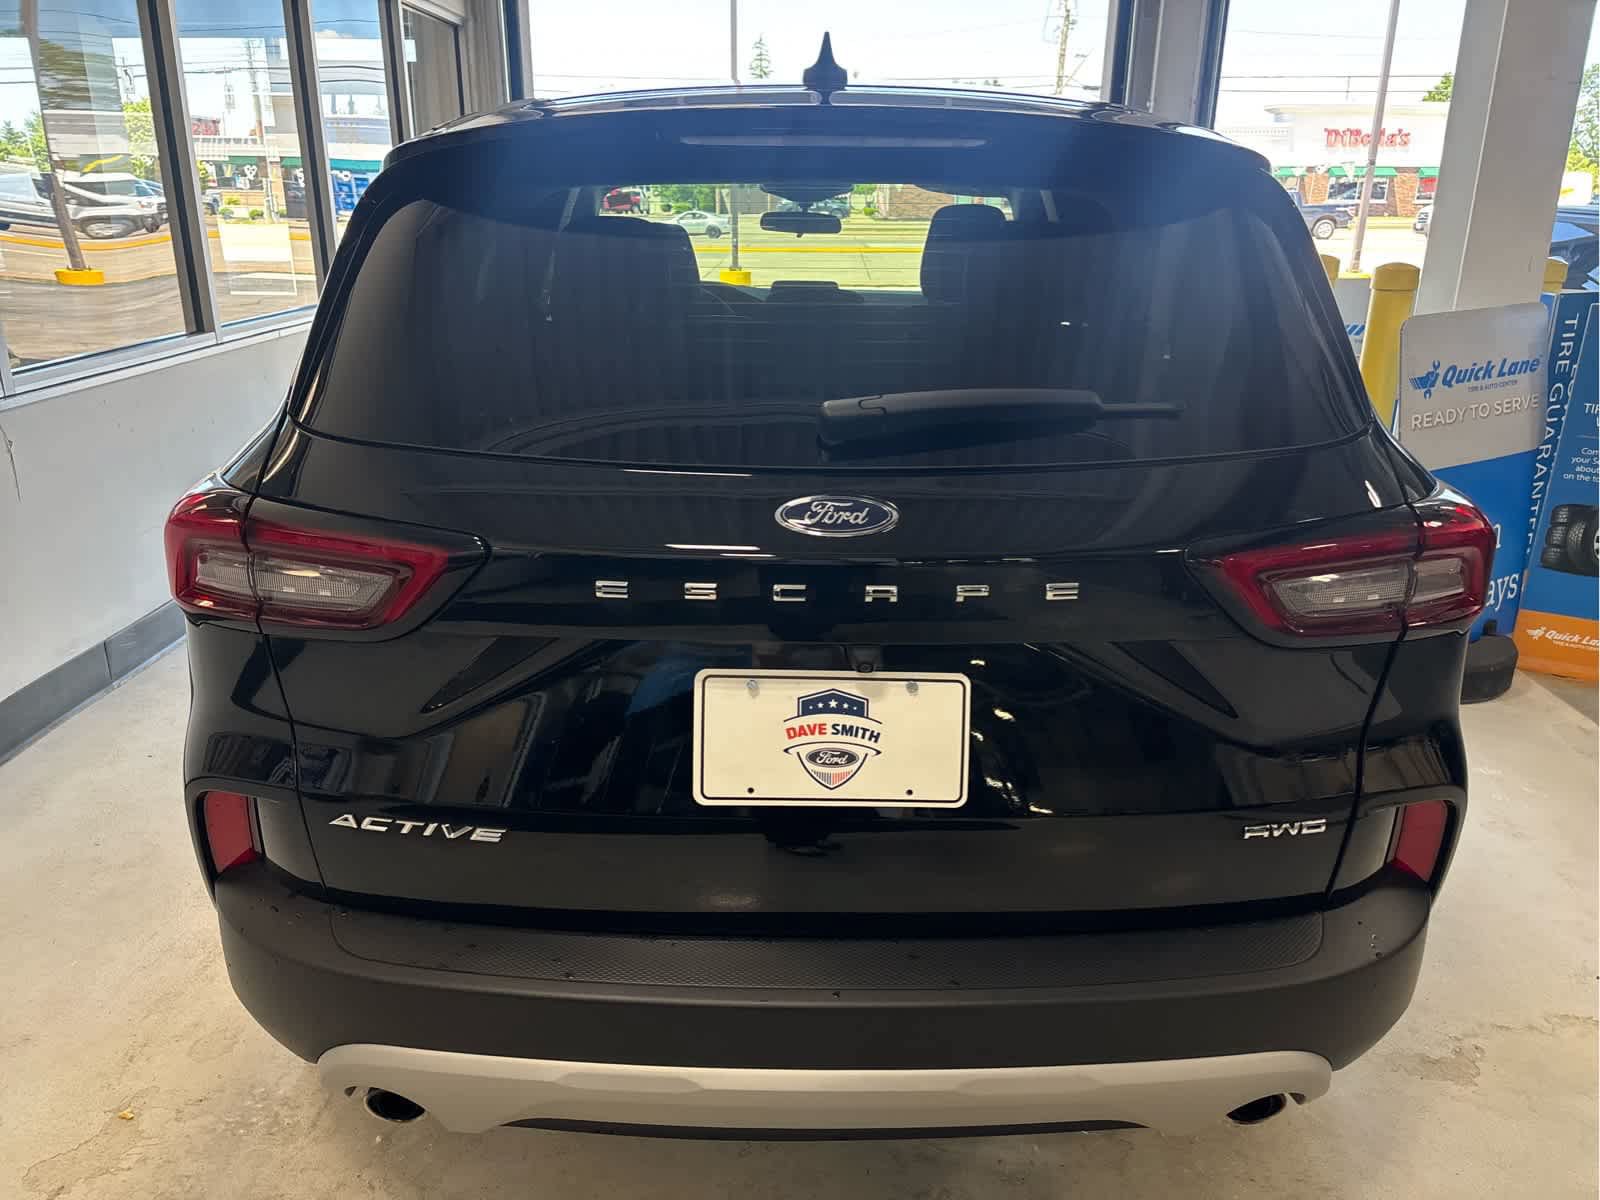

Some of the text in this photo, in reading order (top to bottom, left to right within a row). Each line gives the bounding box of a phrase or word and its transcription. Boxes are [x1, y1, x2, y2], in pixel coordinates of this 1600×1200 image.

[1324, 128, 1410, 147] DiBela's
[1555, 312, 1580, 375] TIRE
[1441, 358, 1541, 388] Quick Lane
[1411, 393, 1540, 431] READY TO SERVE
[1571, 456, 1591, 465] your
[1576, 473, 1592, 482] the
[803, 500, 870, 525] Ford
[595, 580, 1080, 603] ESCAPE
[1485, 573, 1519, 612] ays
[1545, 629, 1582, 643] Quick
[1582, 636, 1599, 647] La
[786, 722, 881, 743] DAVE SMITH
[815, 750, 848, 766] Ford
[329, 813, 507, 843] ACTIVE
[1243, 819, 1327, 840] AWD
